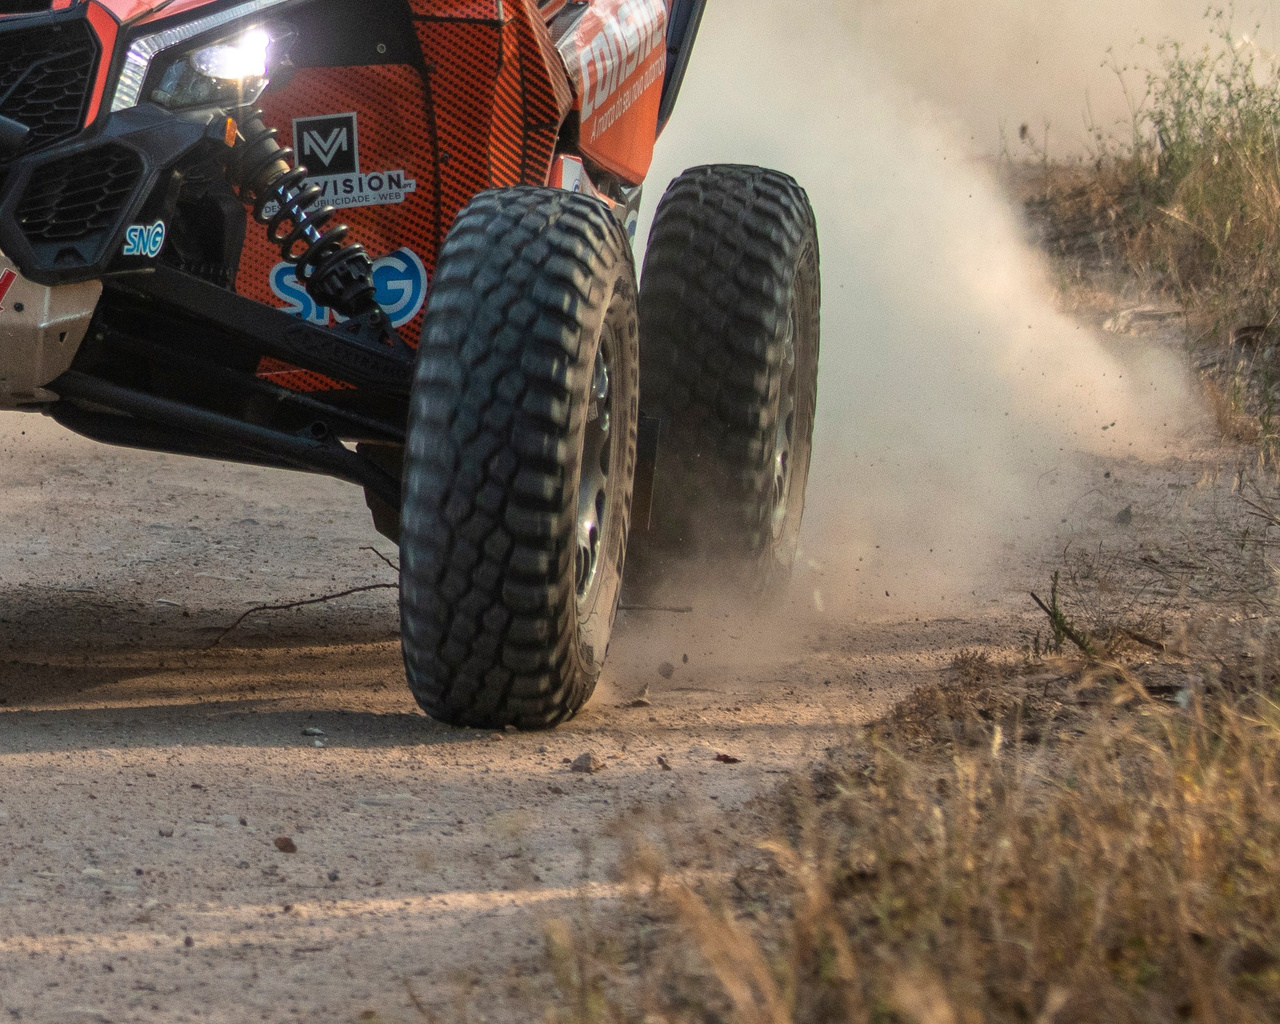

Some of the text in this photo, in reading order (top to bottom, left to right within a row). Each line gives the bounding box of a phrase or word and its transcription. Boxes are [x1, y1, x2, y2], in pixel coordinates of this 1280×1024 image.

[313, 192, 402, 208] UBLICIDADE WEB
[123, 220, 166, 258] SNG
